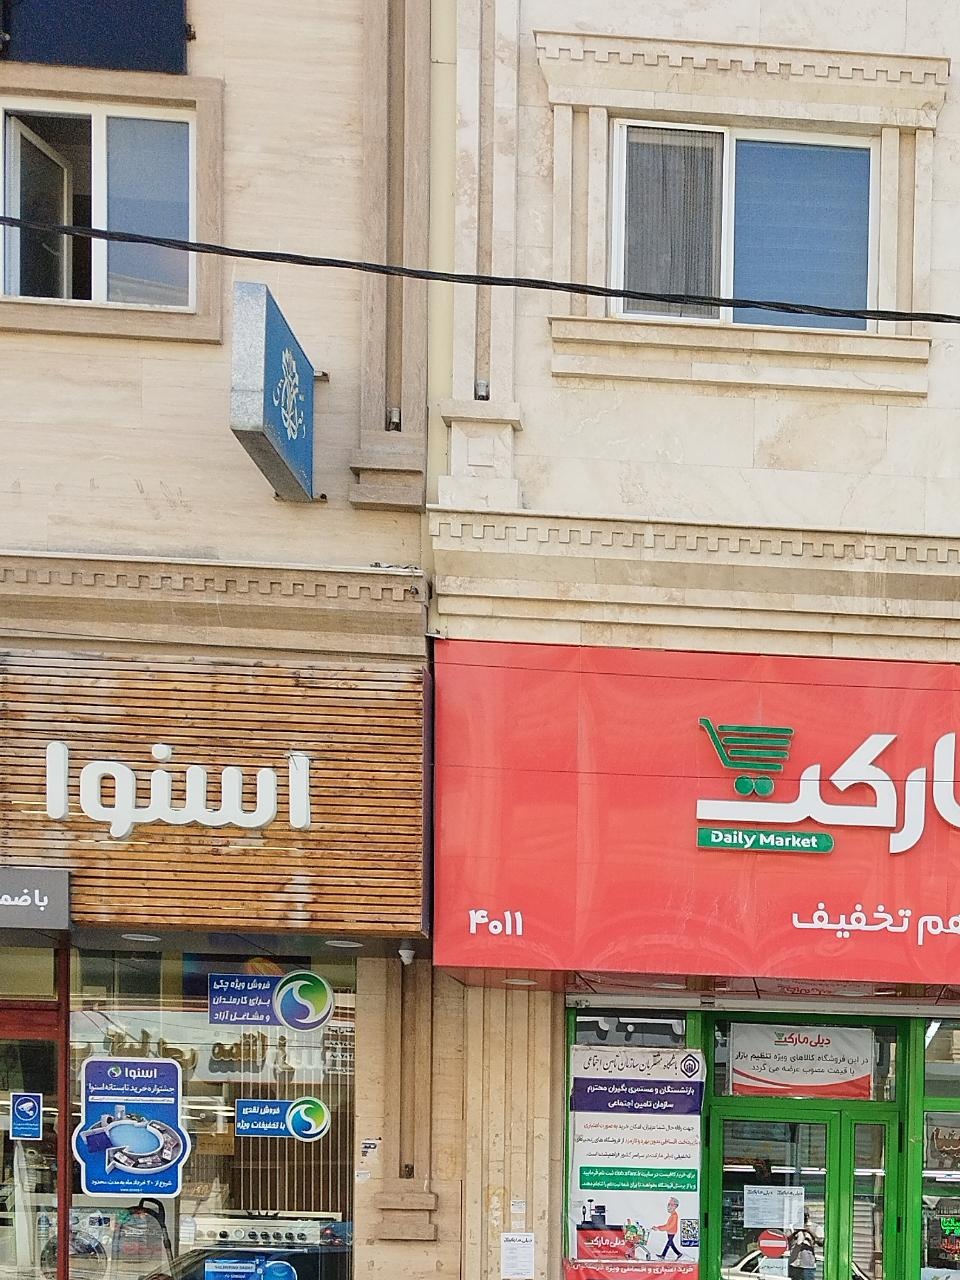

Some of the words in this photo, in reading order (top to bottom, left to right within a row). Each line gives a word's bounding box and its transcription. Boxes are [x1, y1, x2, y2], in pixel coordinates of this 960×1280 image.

[46, 741, 312, 840] اسنوا
[710, 830, 756, 849] Daily
[759, 832, 818, 849] Market
[35, 889, 49, 911] با
[468, 908, 523, 937] ۴۰۱۱
[791, 901, 912, 939] تخفیف
[213, 979, 229, 992] چکی
[230, 978, 247, 991] ویژه
[248, 979, 271, 991] فروش
[213, 996, 248, 1006] کارمندان
[249, 996, 271, 1007] برای
[213, 1010, 229, 1021] آزاد
[230, 1011, 264, 1021] مشاغل
[265, 1014, 271, 1023] و
[774, 1031, 809, 1047] مارکت
[735, 1051, 749, 1061] بازار
[750, 1052, 771, 1062] تنظیم
[774, 1053, 788, 1062] ویژه
[790, 1054, 816, 1063] کالاهای
[818, 1055, 846, 1063] فروشگاه
[848, 1056, 860, 1065] این
[862, 1058, 869, 1066] در
[751, 1063, 767, 1073] گردد
[828, 1067, 848, 1076] قیمت
[125, 1068, 157, 1080] اسنوا
[659, 1085, 694, 1096] بازنشستگان
[608, 1099, 634, 1108] اجتماعی
[633, 1100, 652, 1109] تامین
[652, 1100, 675, 1110] سازمان
[242, 1105, 260, 1115] نقدی
[260, 1104, 281, 1116] فروش
[280, 1120, 286, 1131] با
